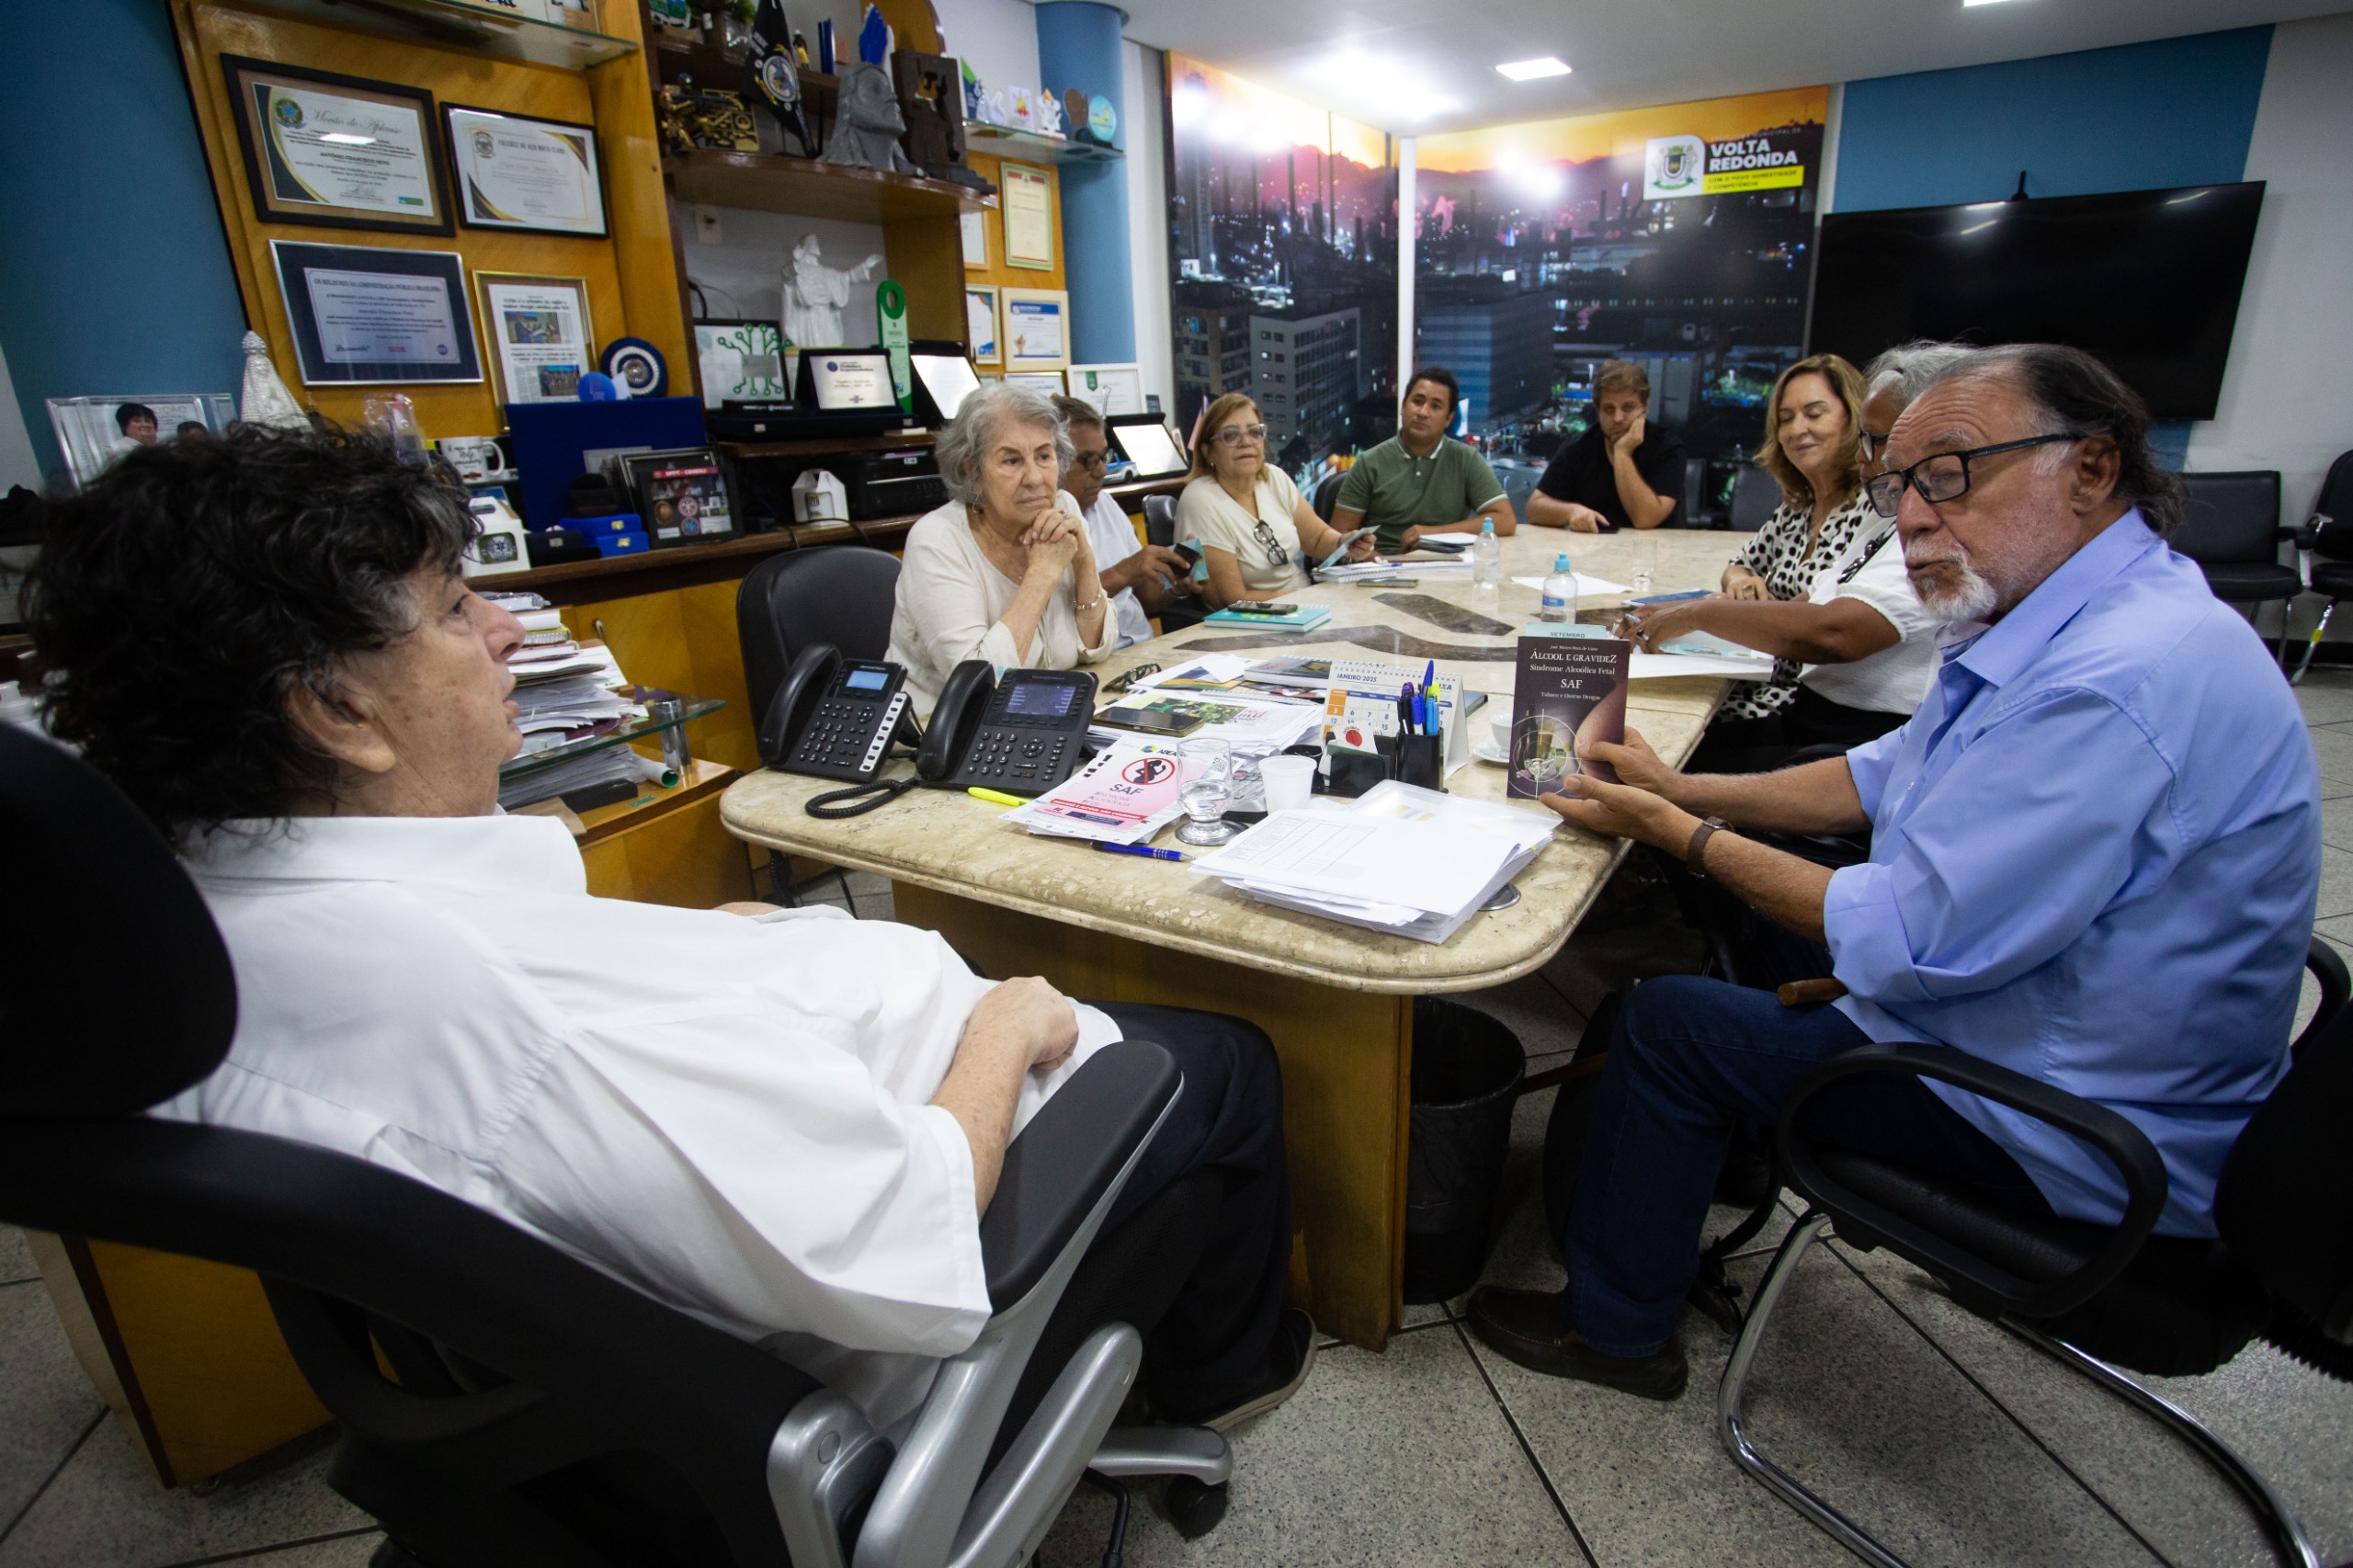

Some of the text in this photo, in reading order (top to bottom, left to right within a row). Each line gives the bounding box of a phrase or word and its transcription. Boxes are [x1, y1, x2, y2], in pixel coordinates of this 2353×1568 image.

[1711, 139, 1770, 157] VOLTA
[1710, 150, 1798, 172] REDONDA
[1530, 648, 1563, 661] ÁLCOOL
[1573, 653, 1617, 663] GRAVIDEZ
[1530, 664, 1563, 672] Síndrome
[1561, 679, 1583, 688] SAF
[1109, 784, 1144, 795] SAF
